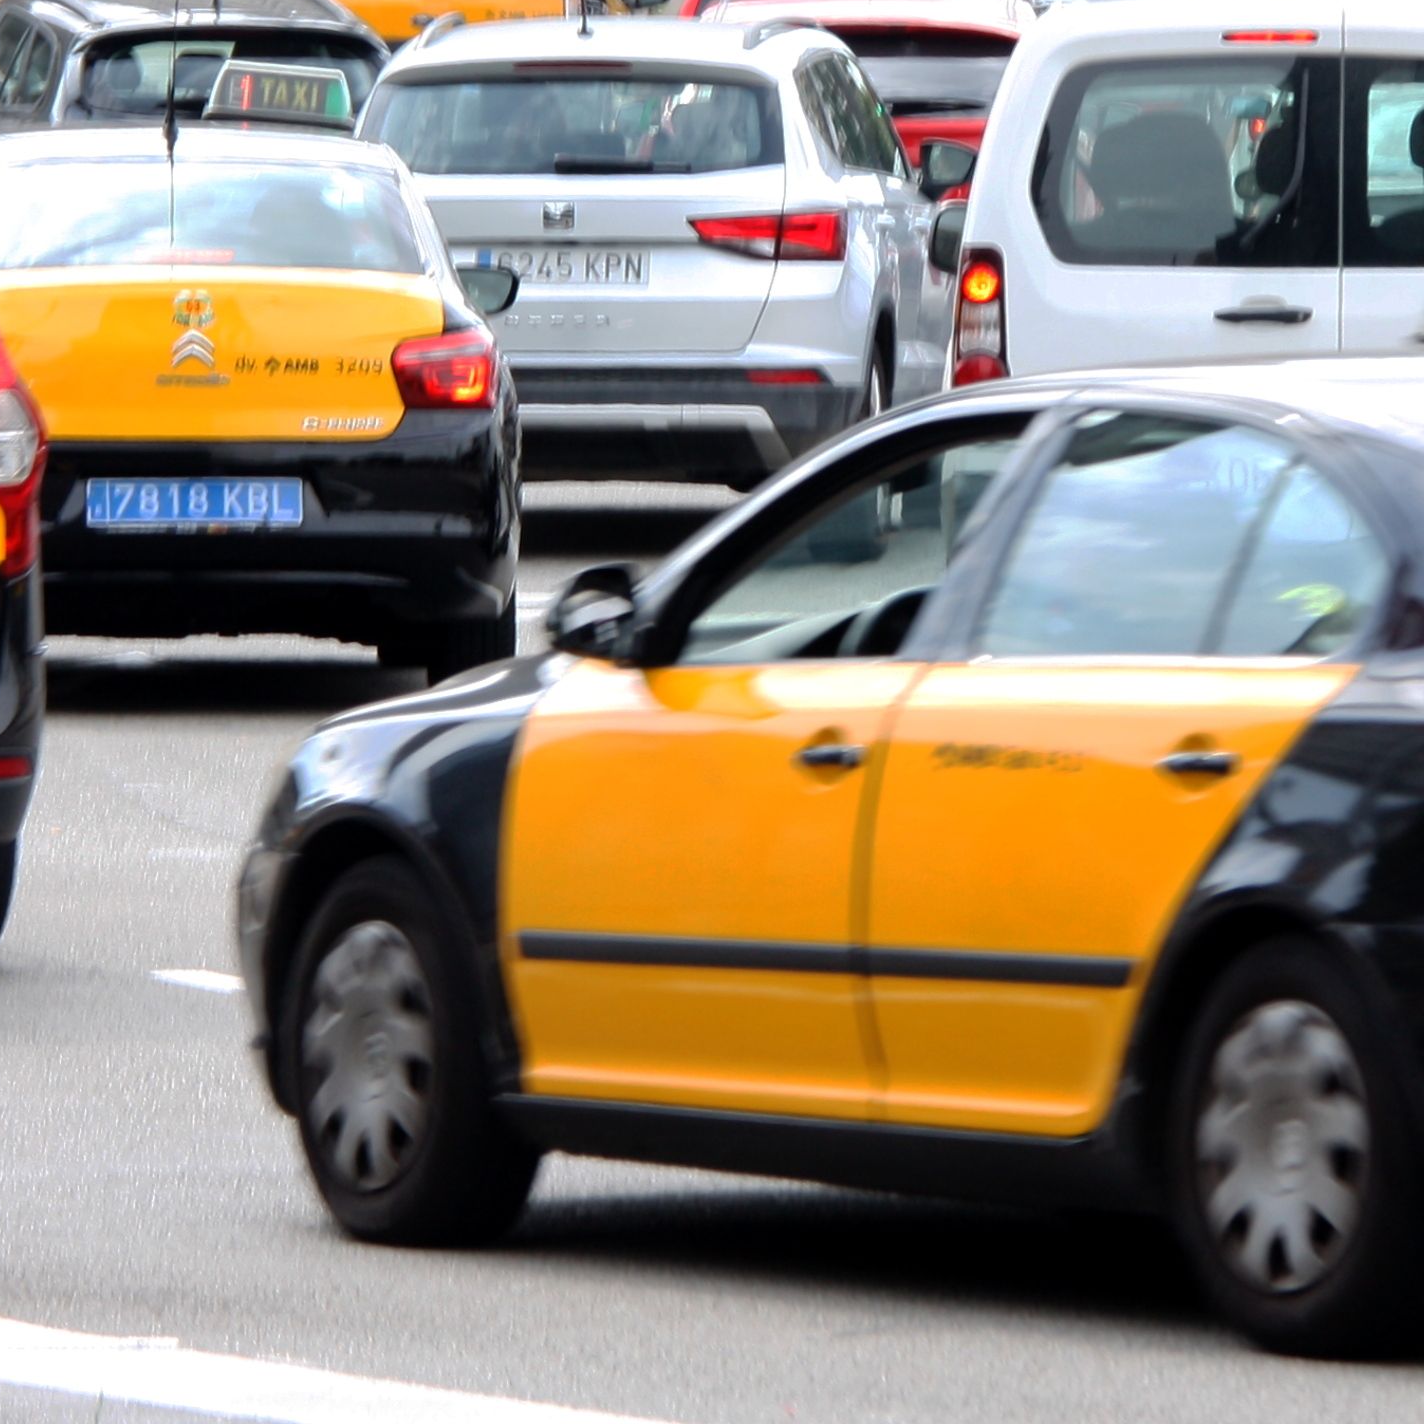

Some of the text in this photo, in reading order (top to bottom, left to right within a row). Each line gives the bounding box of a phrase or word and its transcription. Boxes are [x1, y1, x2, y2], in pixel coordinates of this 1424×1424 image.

[262, 77, 319, 112] TAXI
[584, 252, 643, 282] KPN
[284, 357, 319, 374] AMB
[113, 482, 294, 519] 7818 KBL
